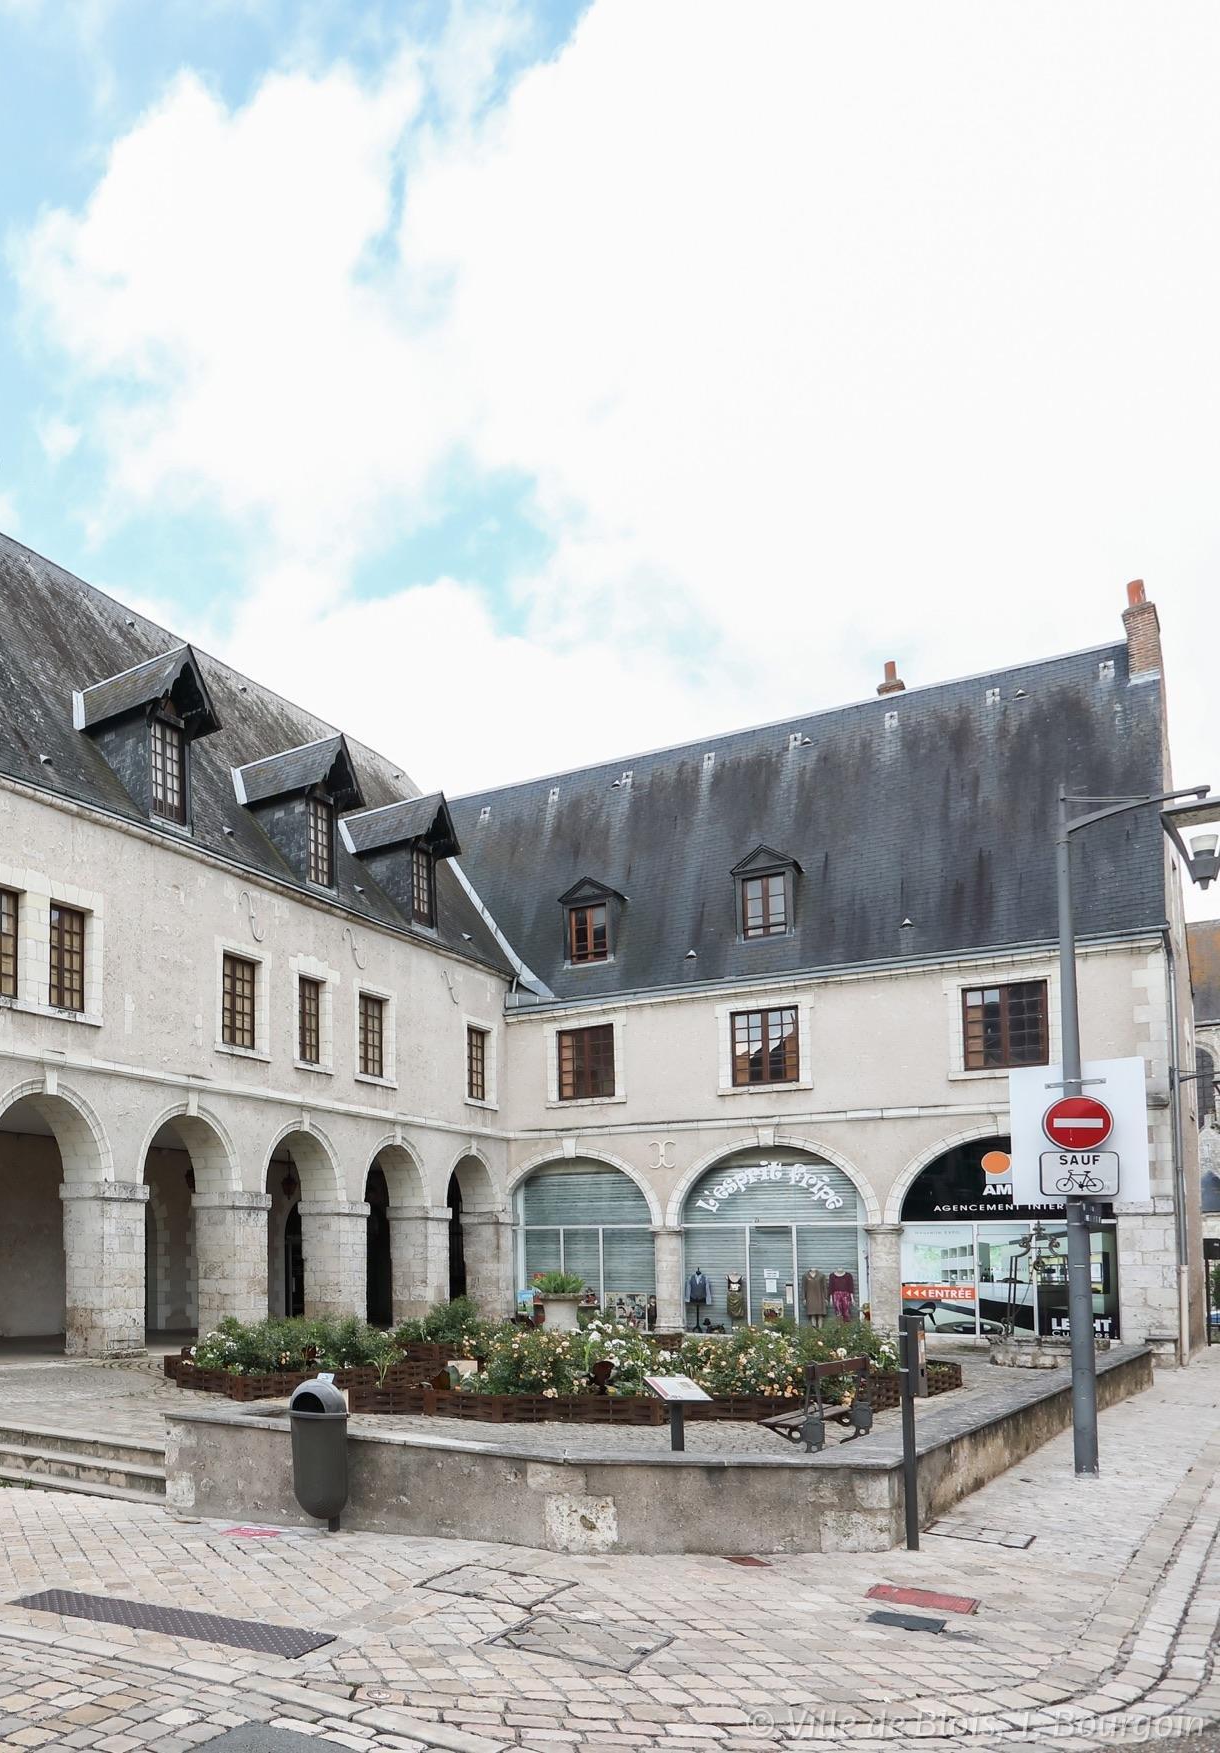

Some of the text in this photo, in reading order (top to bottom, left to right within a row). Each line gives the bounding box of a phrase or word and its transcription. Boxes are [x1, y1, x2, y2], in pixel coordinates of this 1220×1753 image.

[1059, 1154, 1101, 1166] SAUF
[695, 1160, 844, 1213] L'esprit fripe
[928, 1287, 973, 1299] ENTRÉE
[1051, 1317, 1112, 1332] LEHT
